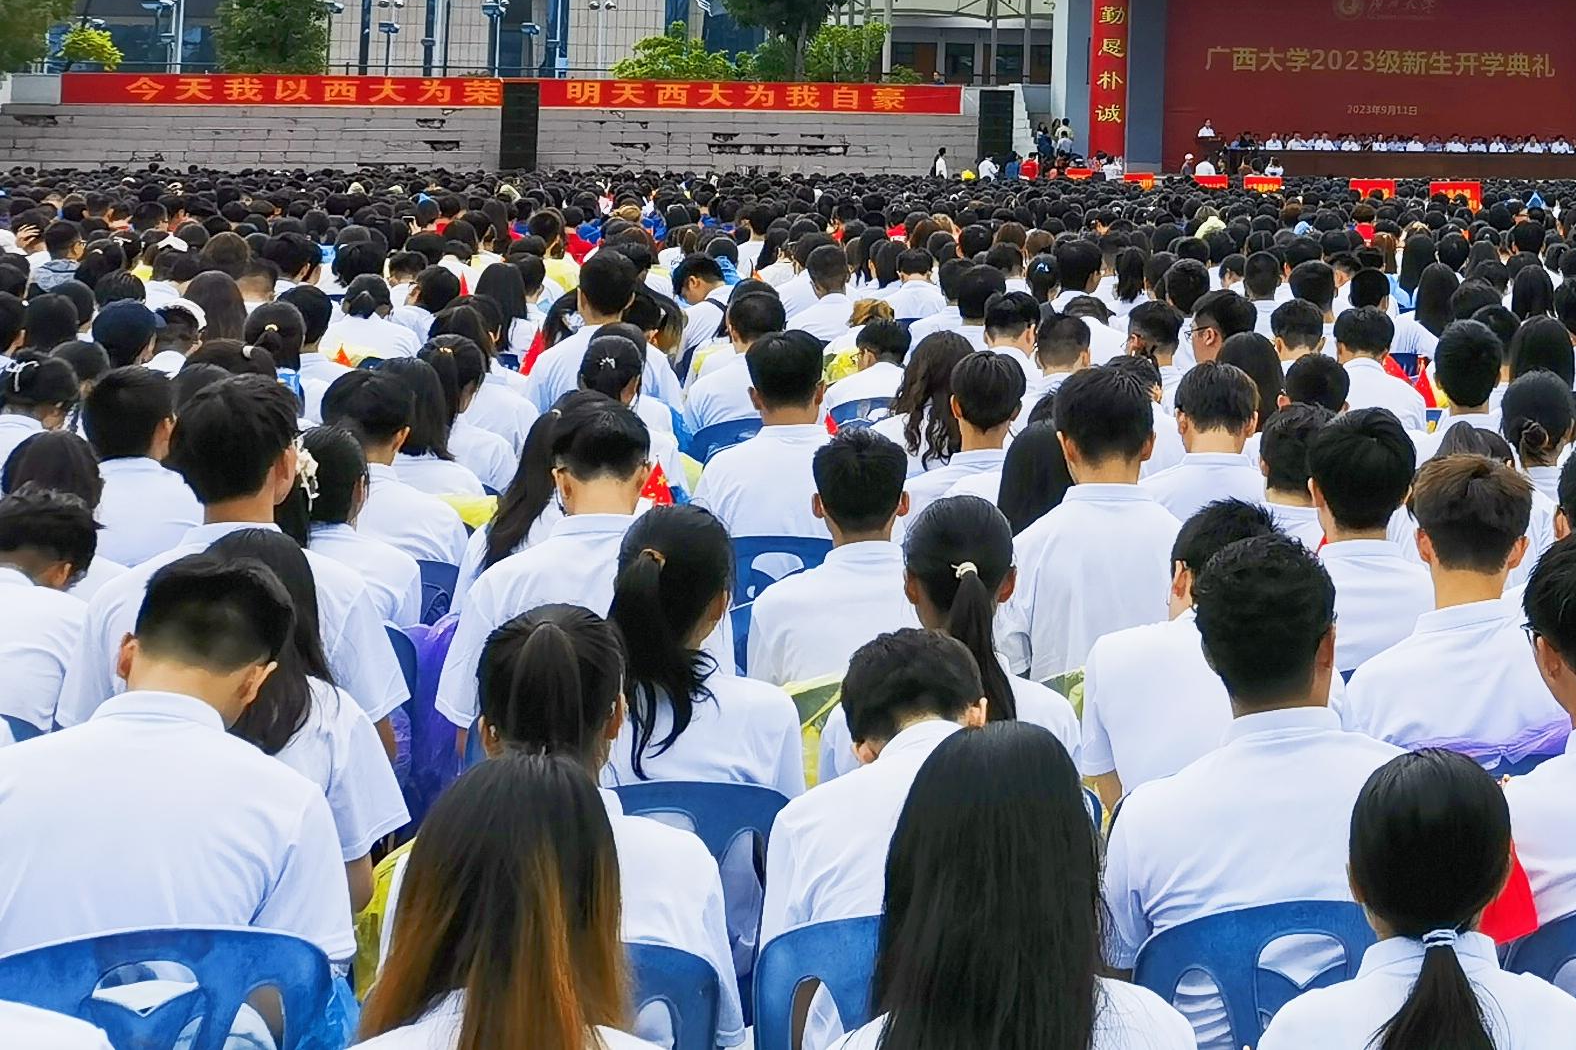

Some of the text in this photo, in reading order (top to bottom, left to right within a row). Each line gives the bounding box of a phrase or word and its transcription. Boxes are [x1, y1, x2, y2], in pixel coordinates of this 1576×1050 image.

[1095, 5, 1126, 124] 勤恳朴诚
[1204, 45, 1556, 79] 广西大学2023级新生开学典礼
[125, 76, 906, 111] 今天我以西大为荣 明天西大为我自豪
[1346, 104, 1419, 117] 2023年9月11日
